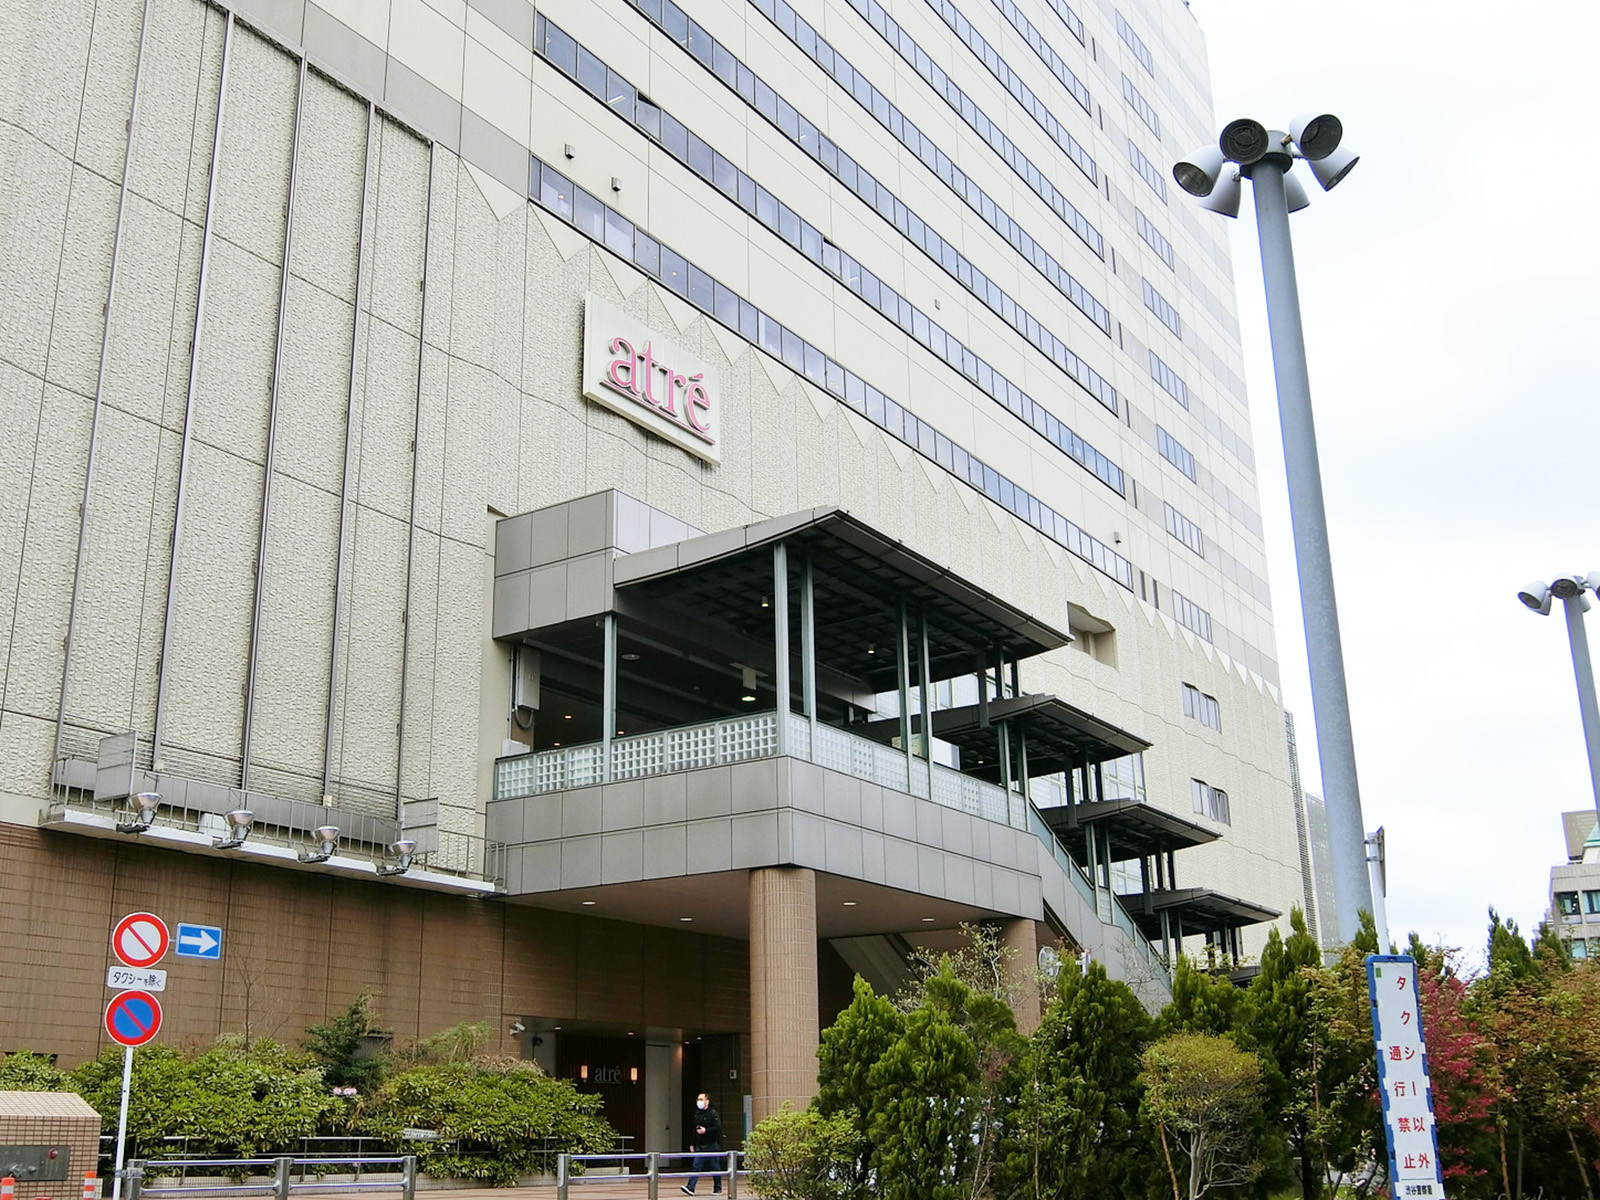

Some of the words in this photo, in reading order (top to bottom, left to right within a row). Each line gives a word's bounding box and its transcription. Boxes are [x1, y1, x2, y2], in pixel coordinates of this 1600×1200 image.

[607, 337, 711, 433] atré
[113, 971, 161, 986] タクシーを除く
[594, 1065, 621, 1083] atré
[1389, 1045, 1416, 1169] 通行禁止
[1396, 976, 1431, 1169] タクシー以外
